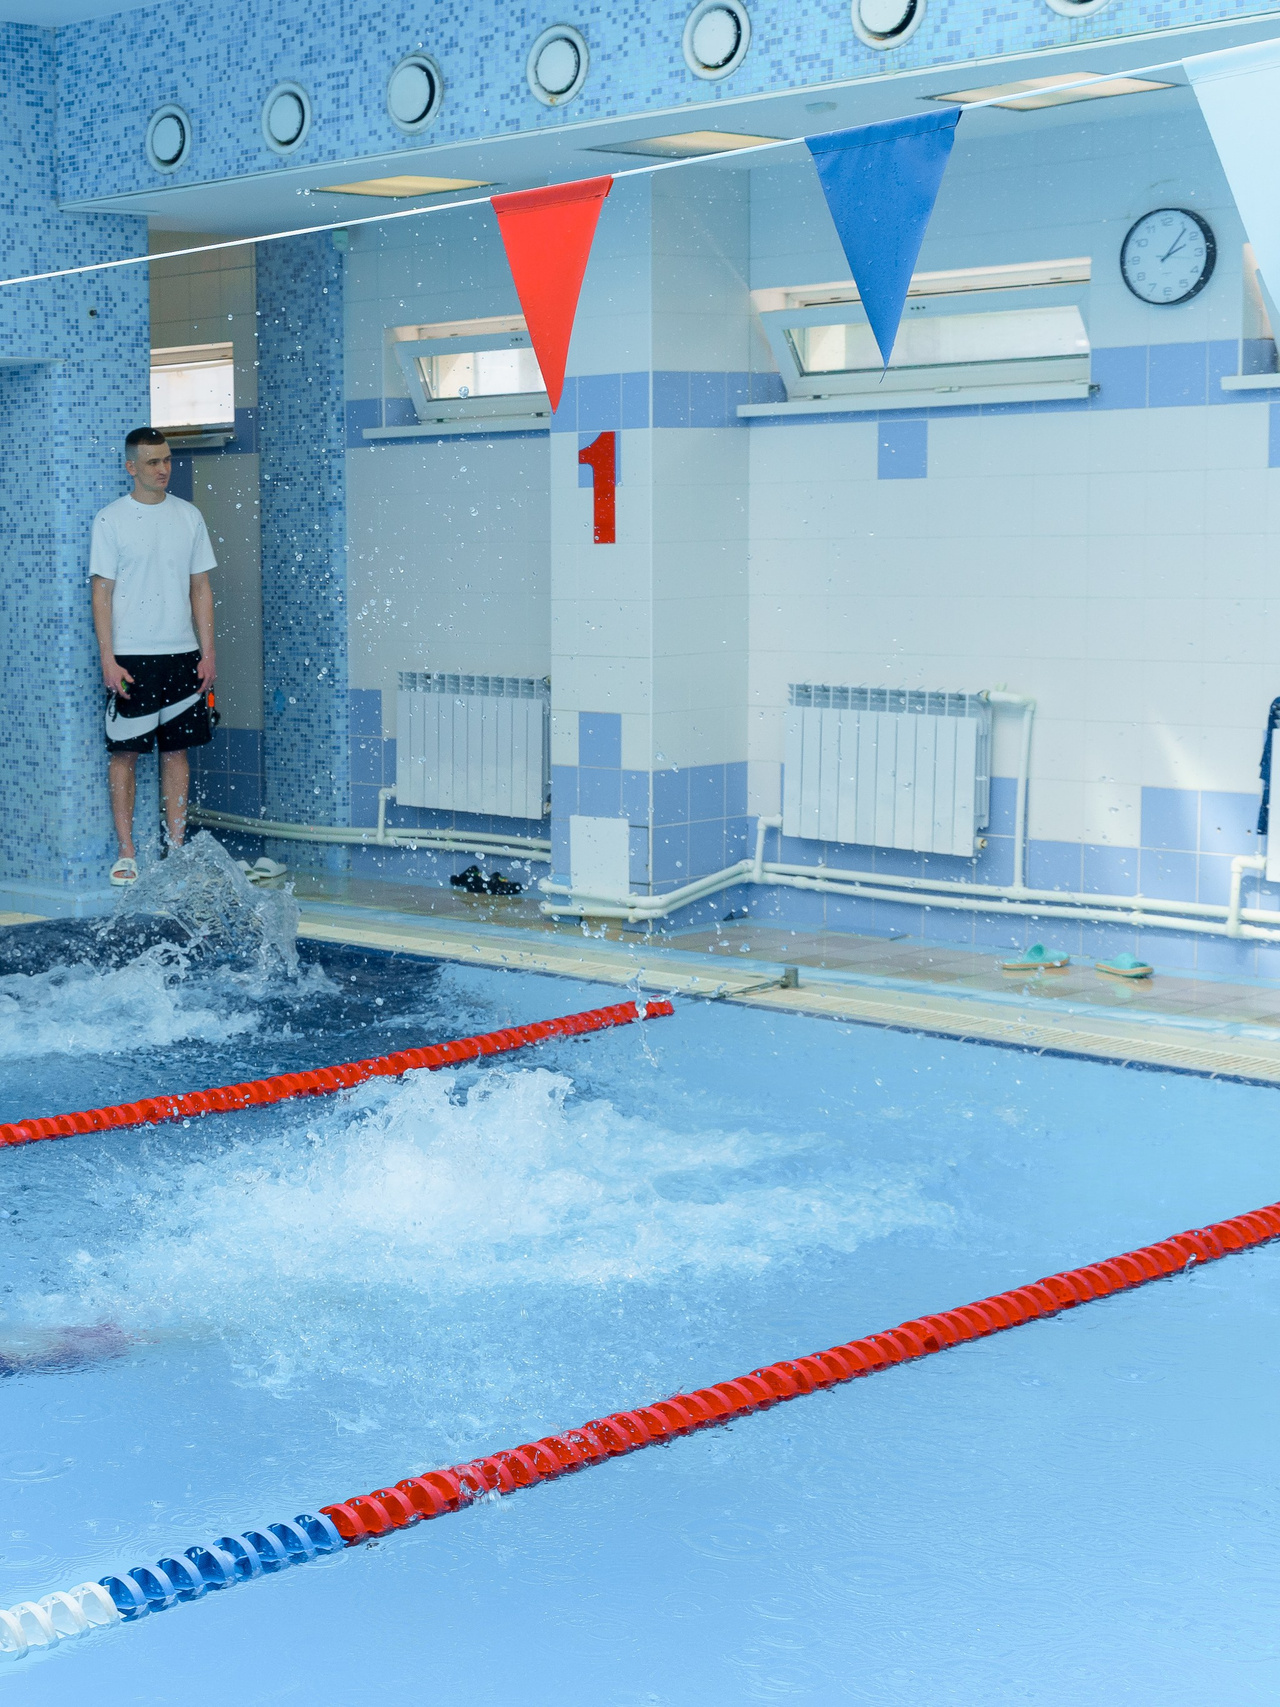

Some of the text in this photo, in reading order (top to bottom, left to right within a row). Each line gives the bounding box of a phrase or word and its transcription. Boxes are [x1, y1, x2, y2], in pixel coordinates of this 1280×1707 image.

[1188, 231, 1199, 241] 2
[1194, 247, 1204, 257] 3
[1190, 265, 1199, 274] 4
[1148, 283, 1157, 292] 7
[1179, 279, 1188, 288] 5
[578, 430, 616, 544] 1
